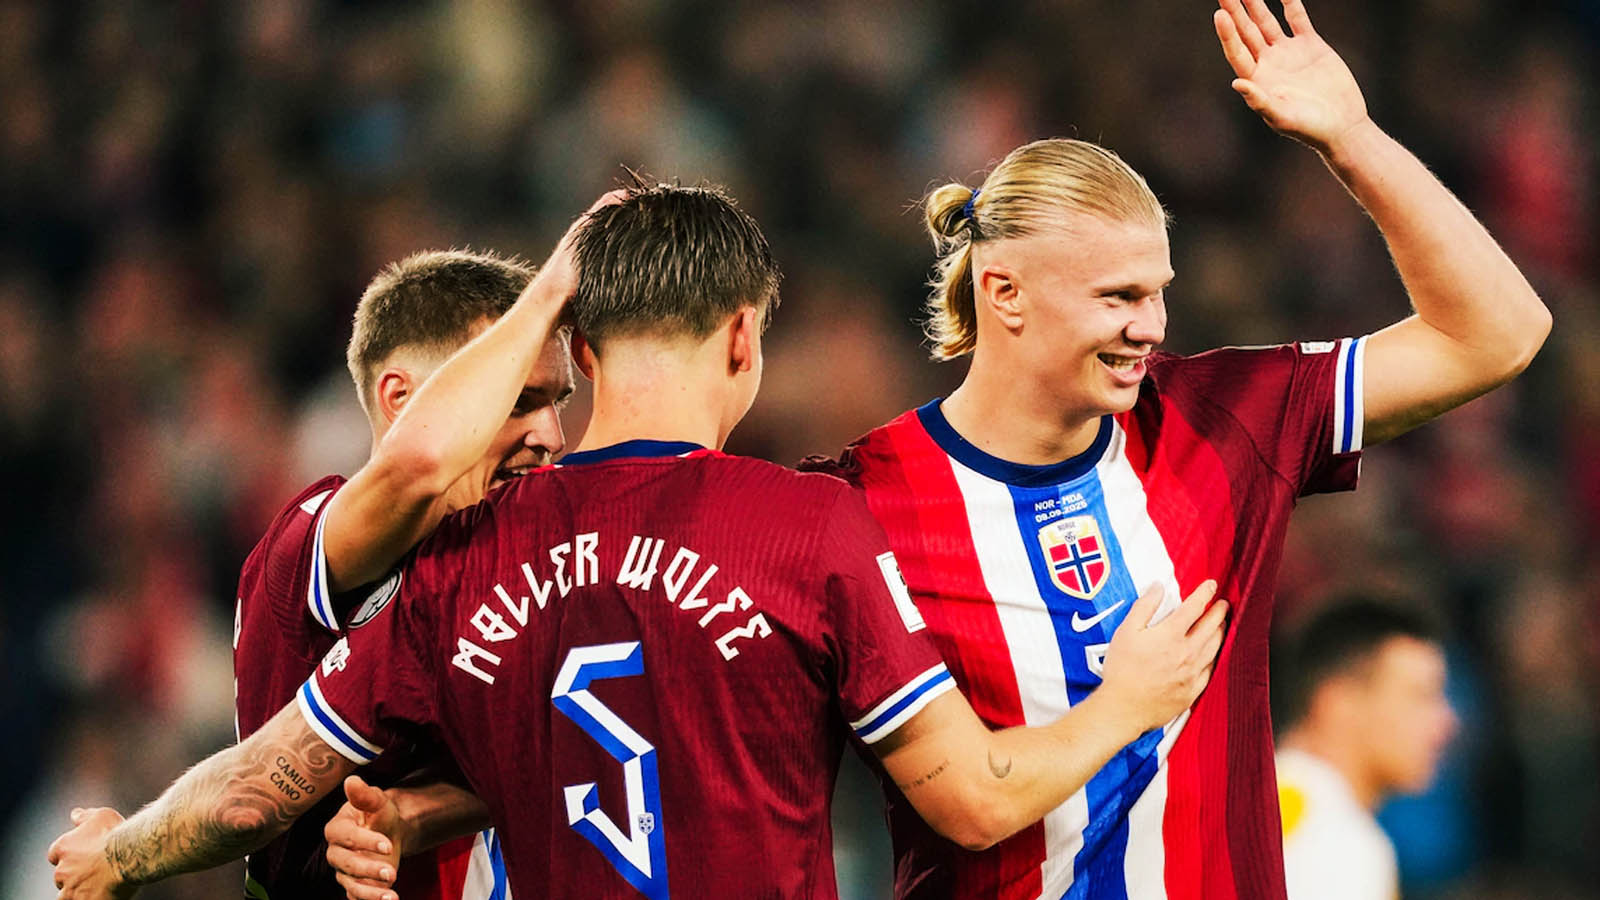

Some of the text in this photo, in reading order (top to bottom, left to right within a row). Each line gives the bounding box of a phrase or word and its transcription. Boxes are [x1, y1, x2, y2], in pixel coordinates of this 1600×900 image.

[1034, 500, 1055, 511] NOR
[1061, 493, 1083, 505] MDA
[452, 532, 773, 685] MØLLER WOLFE
[270, 772, 301, 801] CANO
[276, 756, 316, 794] CAMILO
[551, 641, 671, 900] 5
